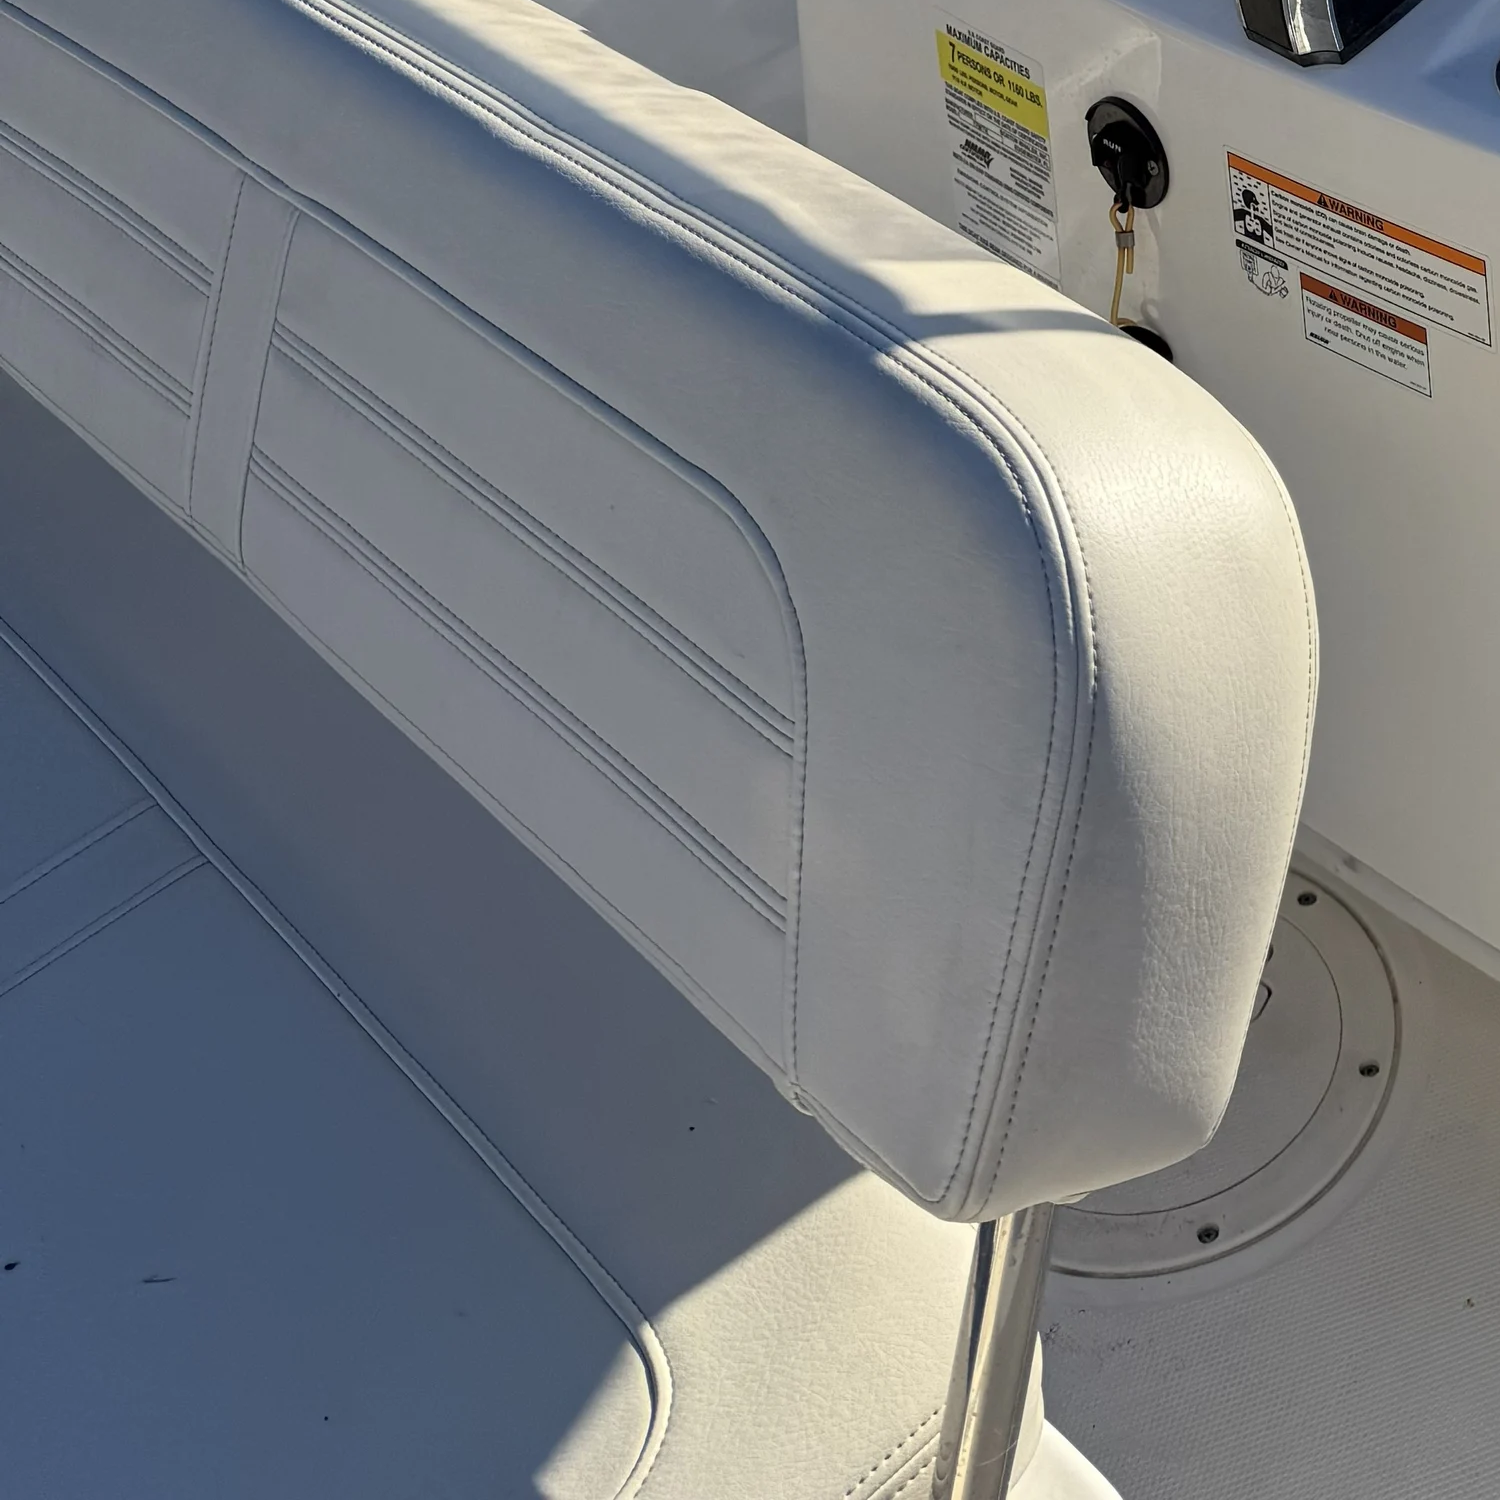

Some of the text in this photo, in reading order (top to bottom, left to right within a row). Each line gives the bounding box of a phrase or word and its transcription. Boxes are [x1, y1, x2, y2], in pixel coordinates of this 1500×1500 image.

[947, 24, 1030, 80] MAXIMUM CAPACITIES
[950, 42, 956, 64] 7
[958, 51, 991, 79] PERSONS
[1026, 89, 1042, 108] LBS.
[1103, 138, 1121, 152] RUN
[1329, 199, 1384, 231] WARNING
[1340, 294, 1397, 329] WARNING
